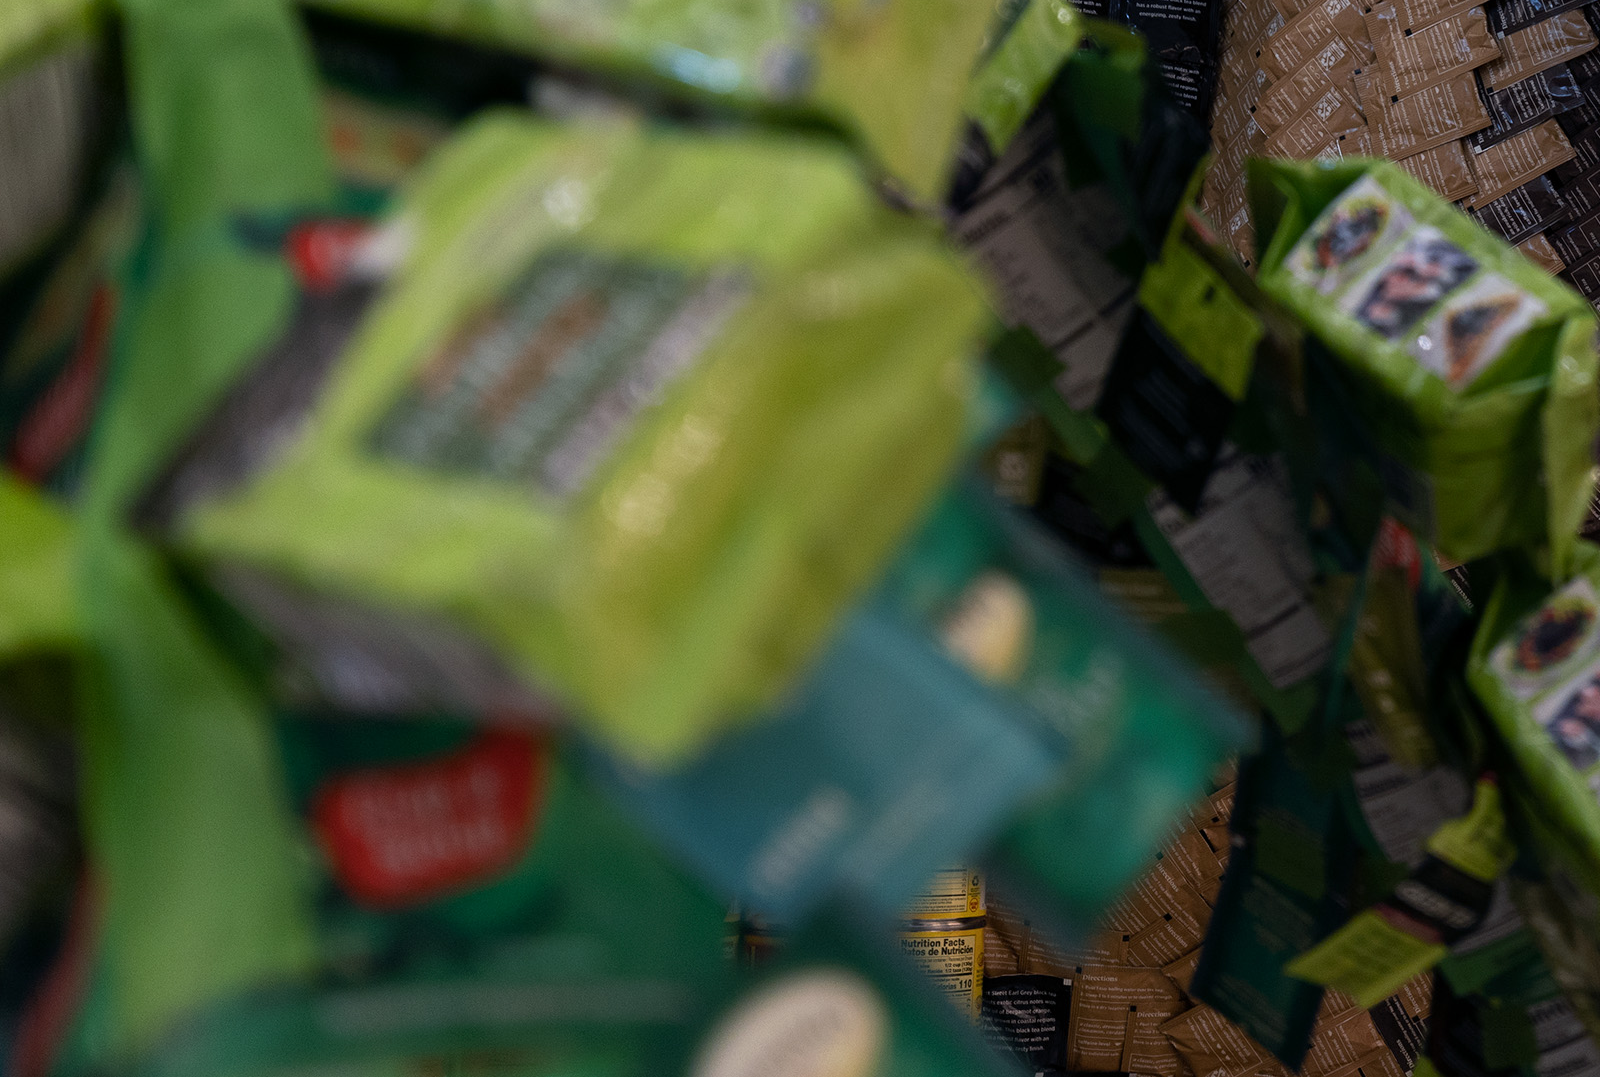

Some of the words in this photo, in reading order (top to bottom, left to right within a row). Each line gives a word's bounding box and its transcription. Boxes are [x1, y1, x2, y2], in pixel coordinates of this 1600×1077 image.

[1155, 862, 1179, 893] Directions
[1164, 923, 1188, 948] Directions
[901, 938, 941, 948] Nutrition
[943, 938, 966, 947] Facts
[928, 947, 939, 956] de
[941, 945, 974, 955] Nutrición
[1082, 974, 1118, 982] Directions
[959, 979, 972, 989] 110
[1137, 1011, 1172, 1019] Directions
